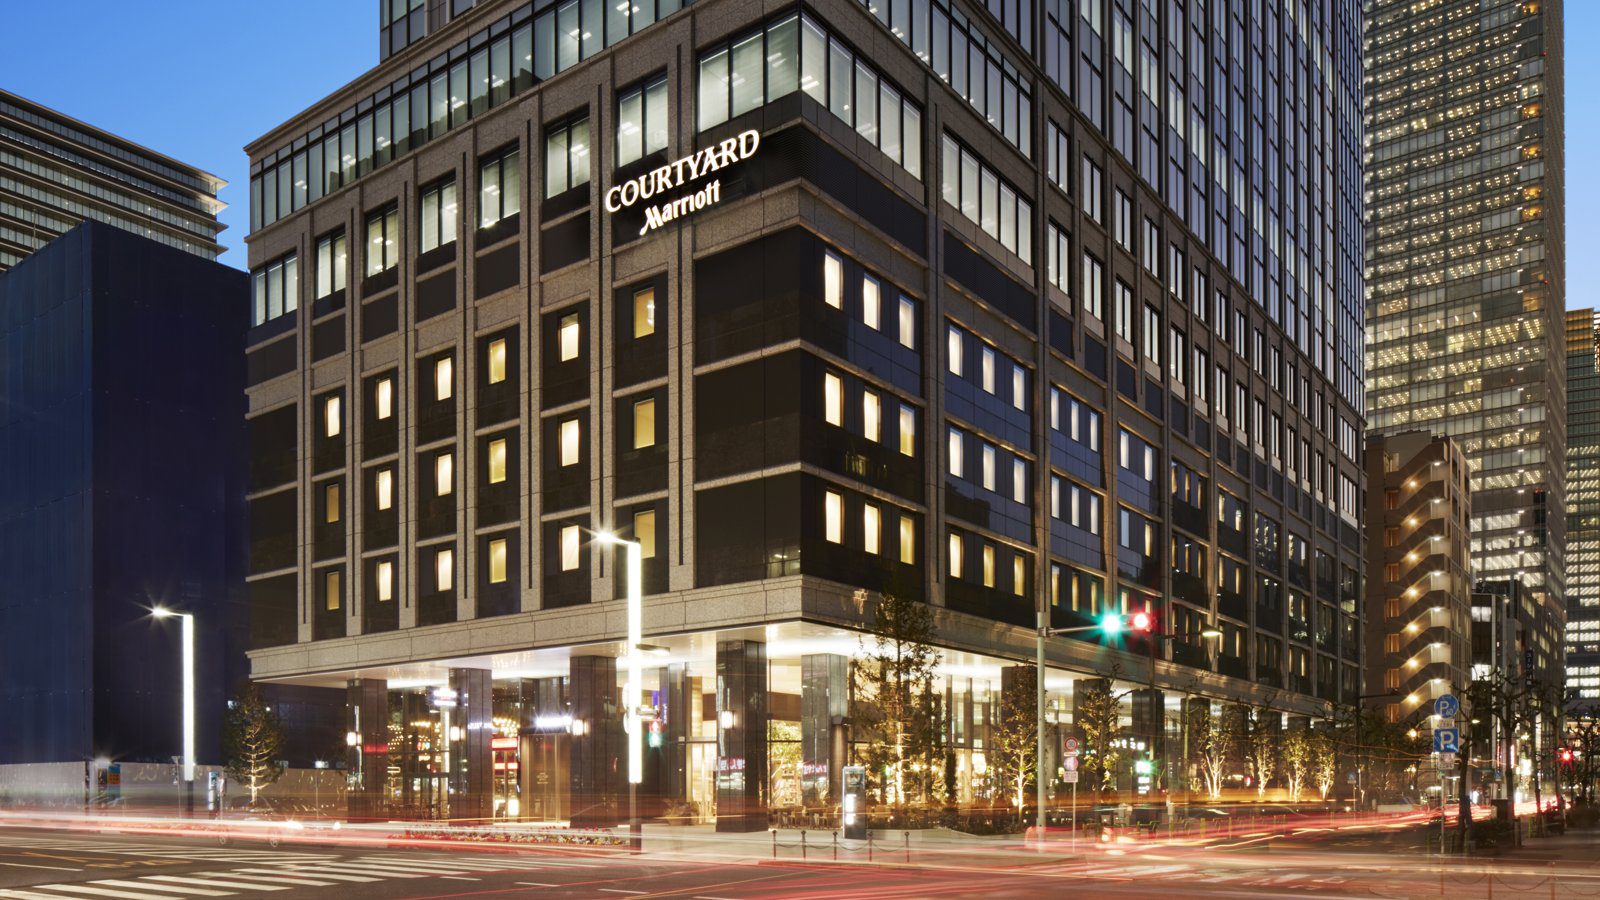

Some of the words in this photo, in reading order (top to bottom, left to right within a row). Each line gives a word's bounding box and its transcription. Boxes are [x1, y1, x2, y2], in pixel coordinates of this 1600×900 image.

[605, 129, 760, 213] COURTYARD
[639, 179, 720, 235] Marriott
[1440, 700, 1450, 716] P
[1440, 731, 1454, 750] P
